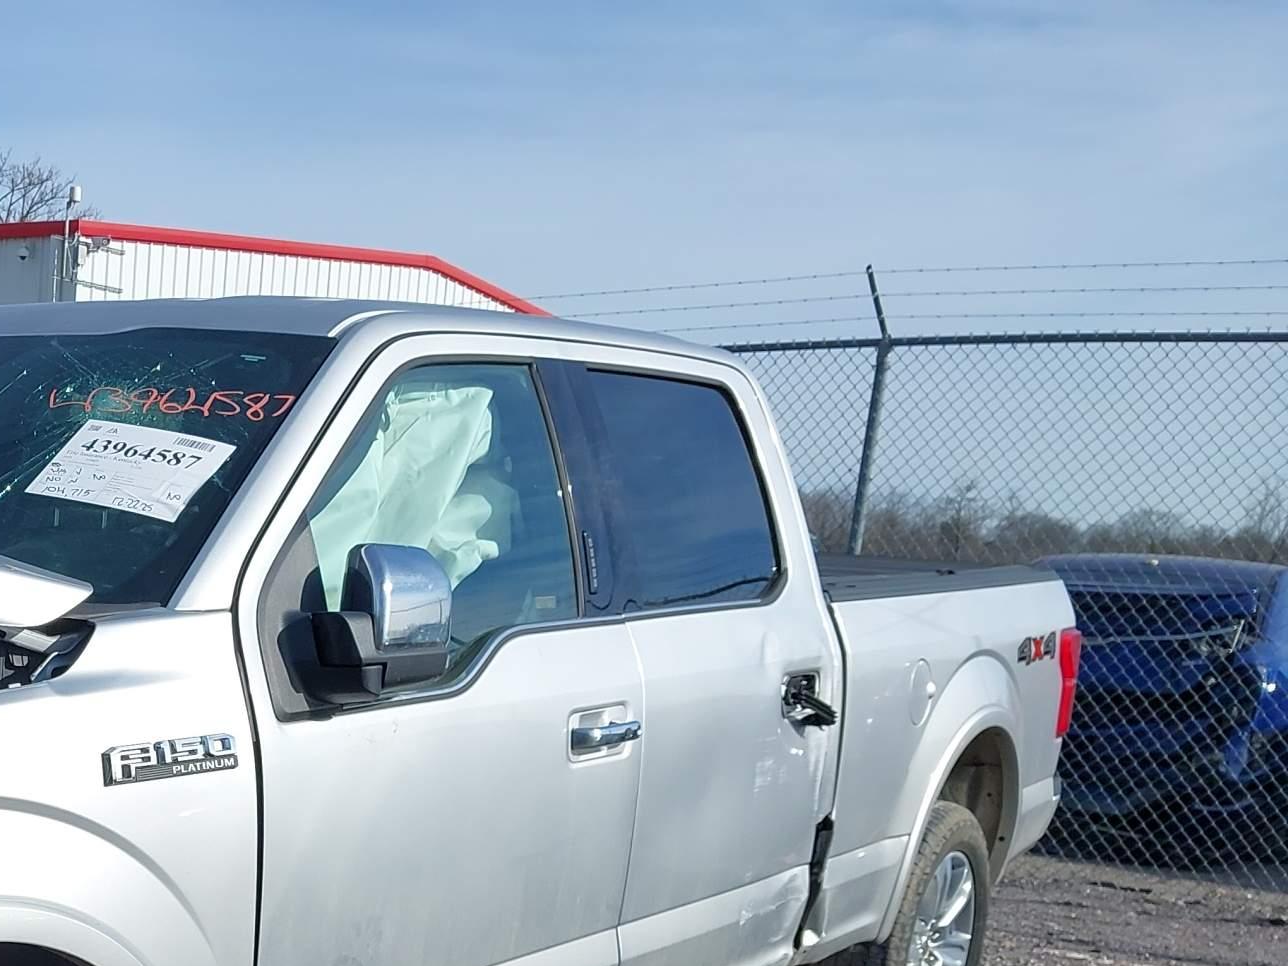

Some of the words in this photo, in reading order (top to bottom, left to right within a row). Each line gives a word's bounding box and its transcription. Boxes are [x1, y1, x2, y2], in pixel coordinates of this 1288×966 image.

[48, 387, 297, 421] 43964587
[80, 438, 203, 470] 43964587
[172, 757, 235, 775] PLATINUM
